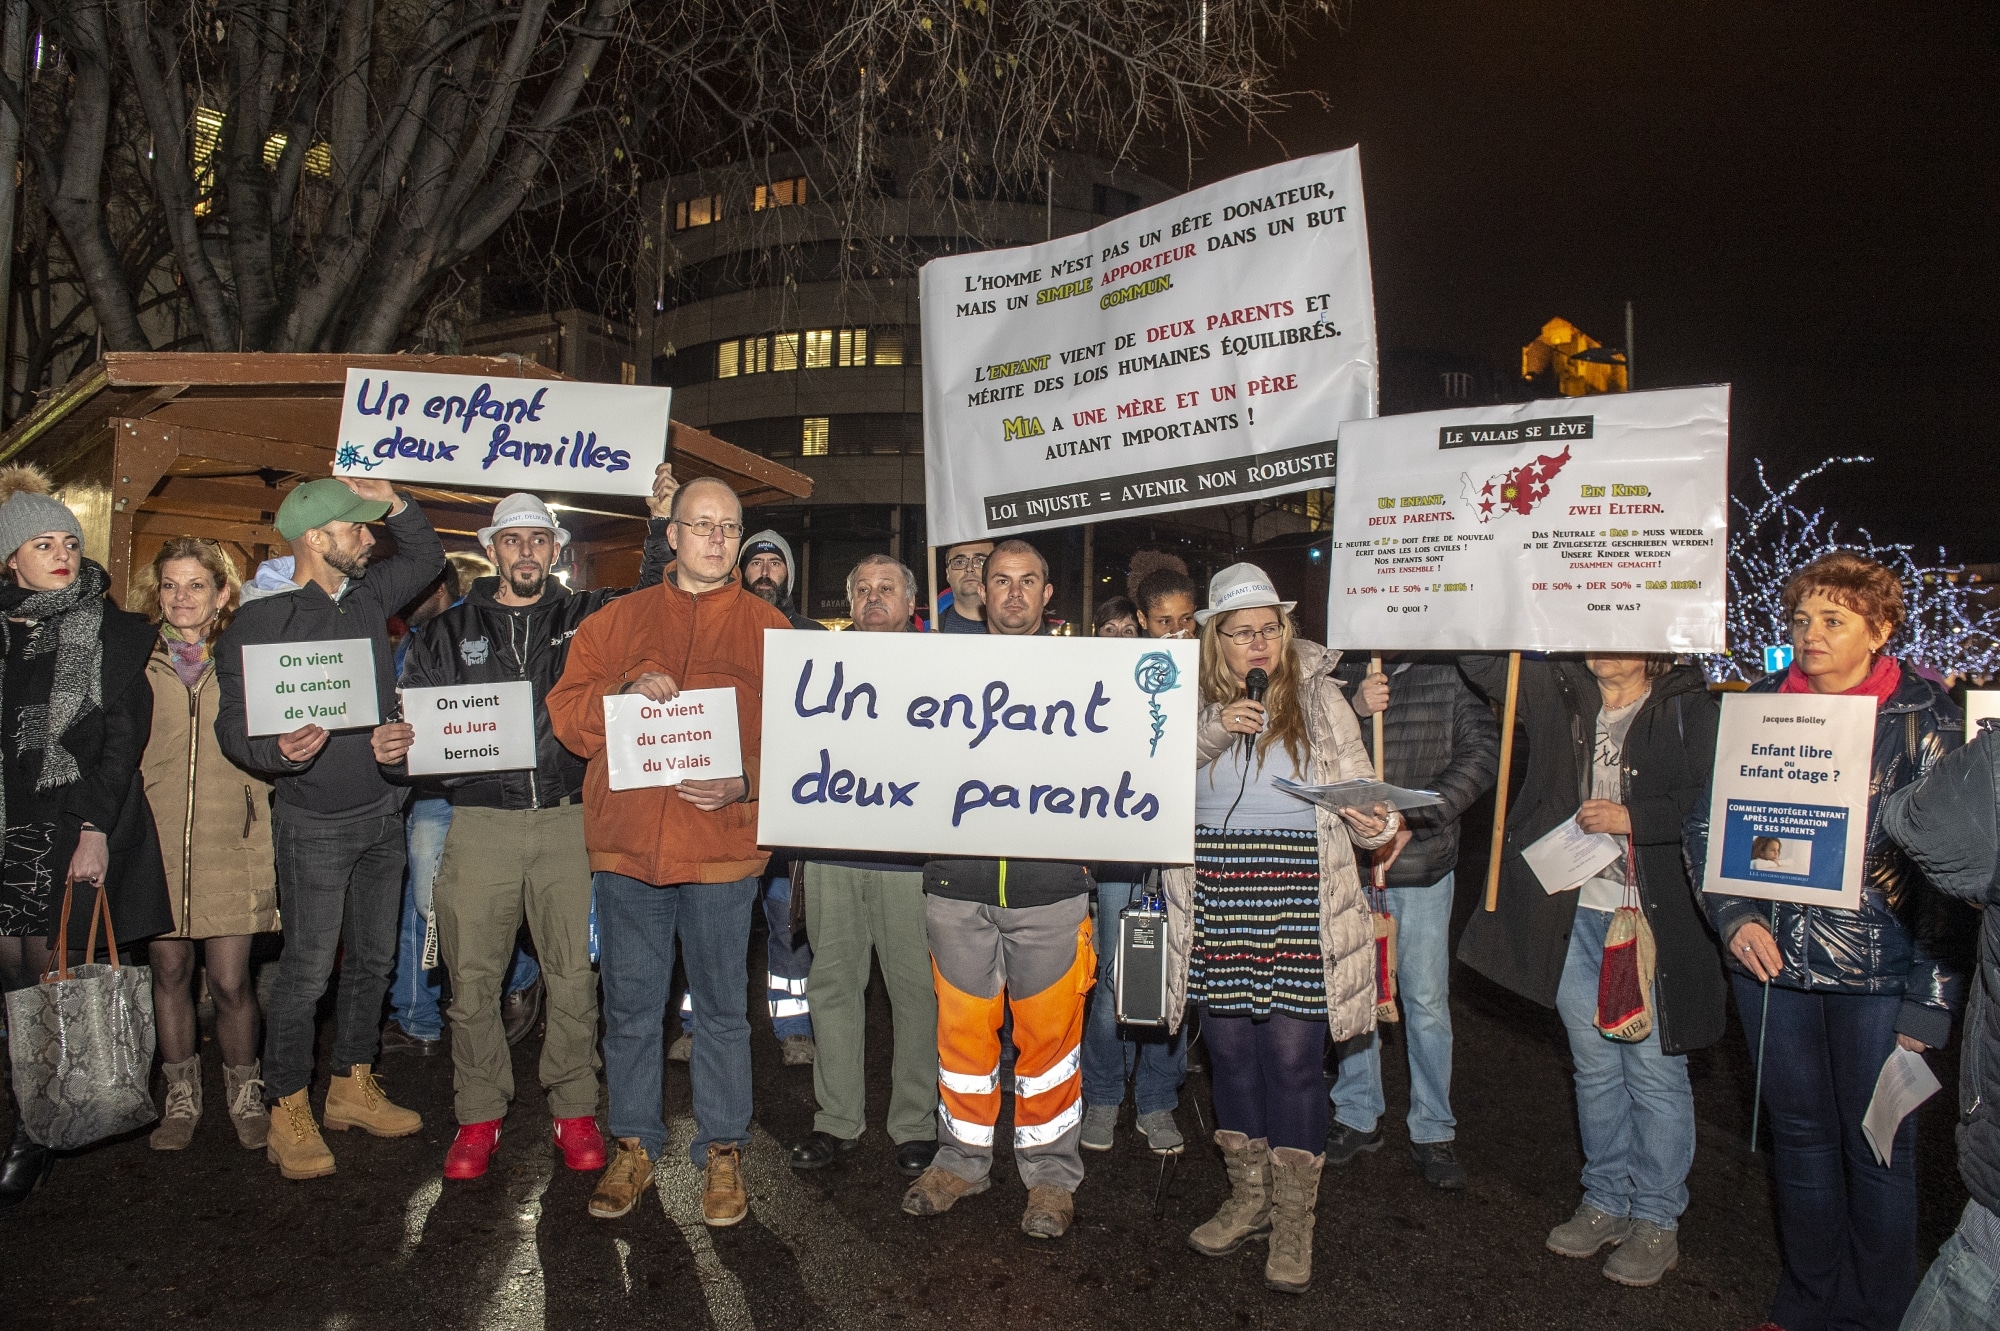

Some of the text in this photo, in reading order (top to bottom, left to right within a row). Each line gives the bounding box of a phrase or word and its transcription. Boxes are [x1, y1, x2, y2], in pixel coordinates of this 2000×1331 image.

[965, 182, 1335, 292] L'HOMME N'EST PAS UN BÊTE DONATEUR,
[957, 206, 1346, 318] MAIS UN SIMPLE APPORTEUR DANS UN BUT
[1100, 274, 1173, 310] COMMUN.
[975, 294, 1330, 383] L'ENFANT VIENT DE DEUX PARENTS ET
[968, 321, 1341, 407] MÉRITE DES LOIS HUMAINES ÉQUILIBRÉS.
[357, 378, 548, 433] Un enfant
[1052, 417, 1063, 432] A
[1073, 407, 1107, 428] UNE
[1116, 397, 1166, 420] MÈRE
[1177, 392, 1199, 408] ET
[1211, 386, 1236, 403] UN
[1248, 374, 1298, 397] PÈRE
[1045, 414, 1238, 460] AUTANT IMPORTANTS
[1471, 429, 1518, 442] VALAIS
[1525, 427, 1542, 437] SE
[1550, 422, 1586, 436] LÈVE
[373, 424, 631, 473] deux familles
[991, 452, 1336, 521] LOI INJUSTE AVENIR NON ROBUSTE
[1400, 494, 1446, 507] ENFANT,
[1569, 506, 1601, 515] ZWEI
[1369, 512, 1454, 526] DEUX PARENTS.
[1346, 540, 1370, 548] NEUTRE
[1434, 544, 1460, 552] CIVILES
[1444, 583, 1467, 592] 100%
[1552, 582, 1572, 590] 50%
[1645, 581, 1667, 589] DAS
[280, 652, 343, 668] On vient
[275, 677, 350, 694] du canton
[437, 695, 500, 710] On vient
[795, 659, 1110, 749] Un enfant
[284, 702, 347, 720] de Vaud
[641, 703, 704, 719] On vient
[443, 720, 497, 735] du Jura
[1763, 715, 1826, 726] Jacques Biolley
[637, 730, 712, 746] du canton
[445, 744, 499, 760] bernois
[1752, 744, 1832, 759] Enfant libre
[643, 754, 711, 772] du Valais
[1740, 765, 1828, 784] Enfant otage
[792, 749, 1160, 828] deux parents
[1729, 804, 1846, 819] COMMENT PROTÉGER L'ENFANT
[1743, 814, 1767, 822] APRÈS
[1780, 816, 1828, 827] SÉPARATION
[1781, 826, 1815, 835] PARENTS
